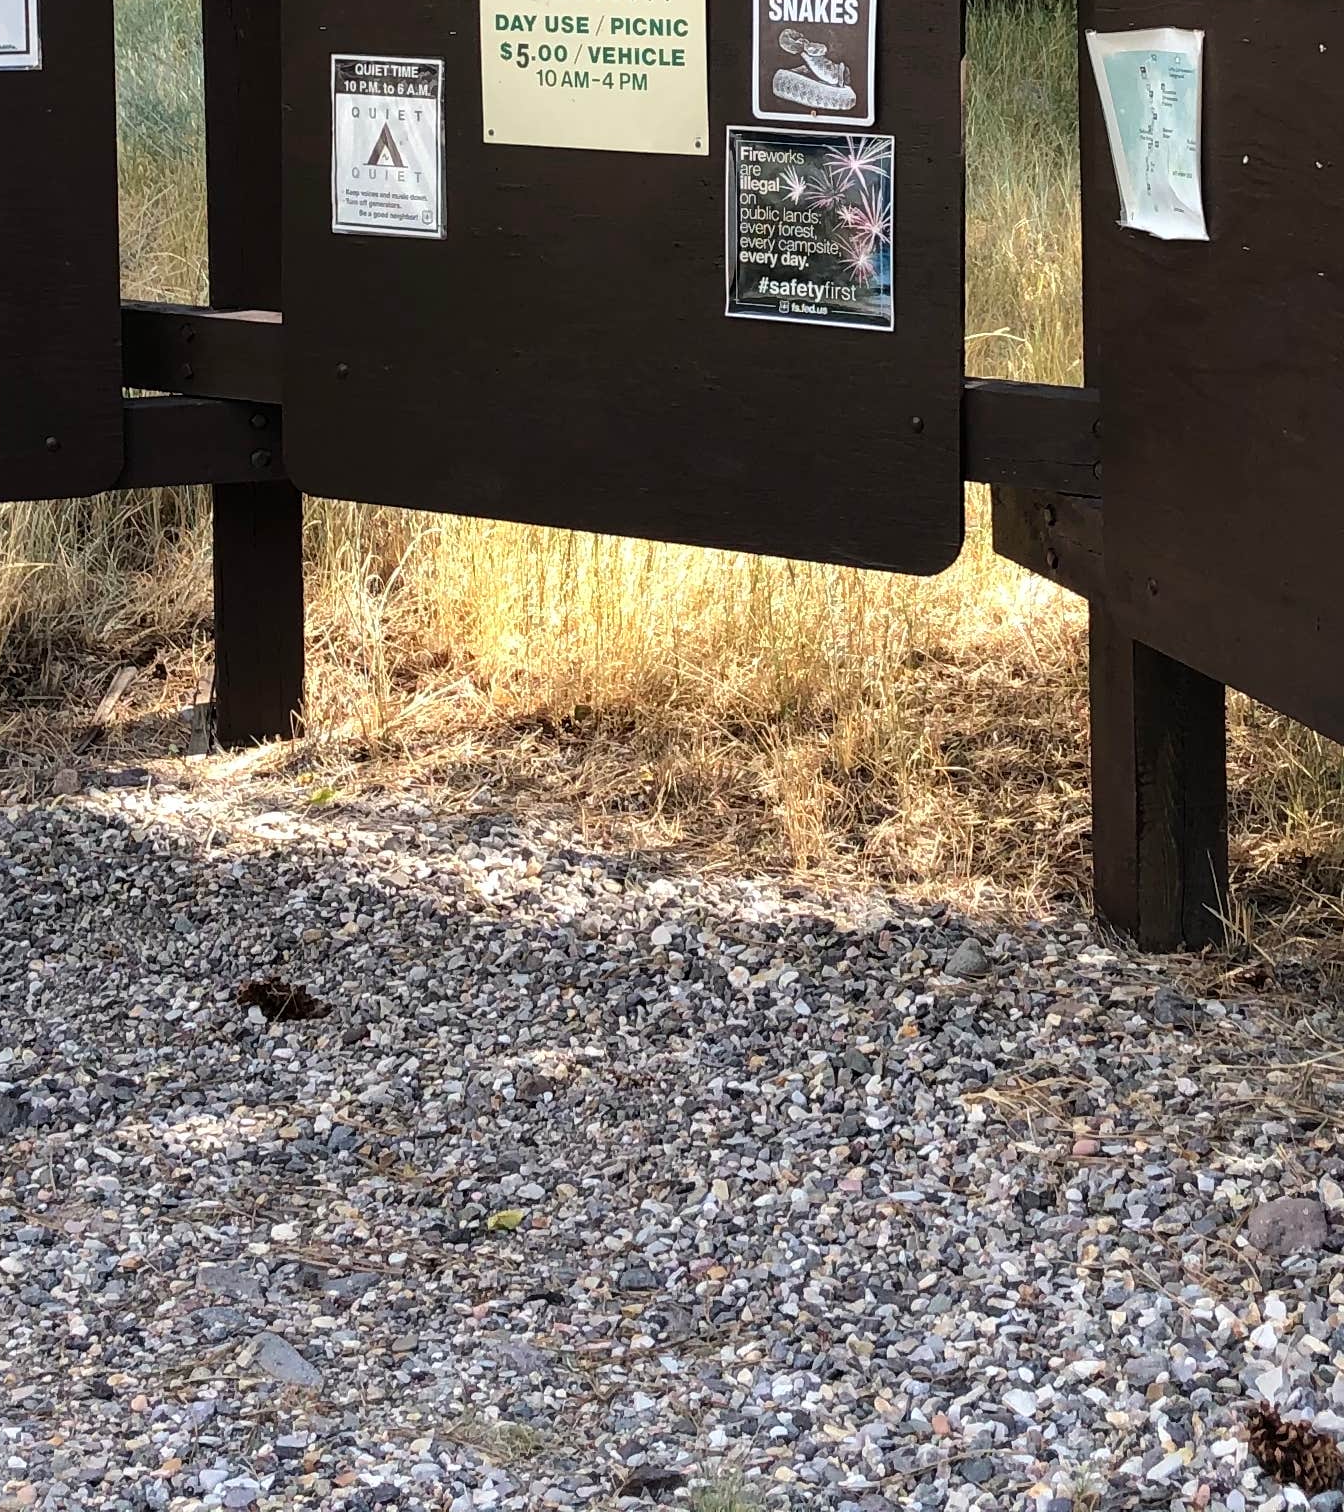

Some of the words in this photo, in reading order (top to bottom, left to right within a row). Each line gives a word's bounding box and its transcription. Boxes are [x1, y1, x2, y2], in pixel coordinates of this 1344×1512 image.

[495, 14, 537, 32] DAY
[545, 15, 589, 34] USE
[595, 15, 604, 36] /
[610, 17, 688, 37] PICNIC
[500, 41, 568, 68] $5.00
[574, 44, 583, 64] /
[588, 46, 685, 66] VEHICLE
[355, 63, 389, 77] QUIET
[391, 65, 419, 78] TIME
[344, 80, 356, 92] 10
[360, 82, 381, 93] P.M.
[383, 83, 394, 94] to
[397, 83, 404, 94] 6
[406, 84, 431, 96] A.M.
[536, 69, 557, 87] 10
[620, 73, 648, 91] PM
[351, 106, 422, 121] QUIET
[740, 147, 804, 164] Fireworks
[351, 167, 422, 183] QUIET
[740, 164, 761, 176] are
[740, 177, 780, 194] illegal
[740, 192, 756, 204] on
[740, 207, 779, 222] public
[783, 209, 822, 224] lands:
[740, 223, 775, 237] every
[778, 222, 817, 240] forest,
[740, 237, 775, 252] every
[778, 239, 842, 257] campsite,
[740, 251, 778, 268] every
[781, 253, 809, 270] day.
[758, 276, 856, 302] #safetyfirst
[791, 302, 828, 315] fs.fed.us
